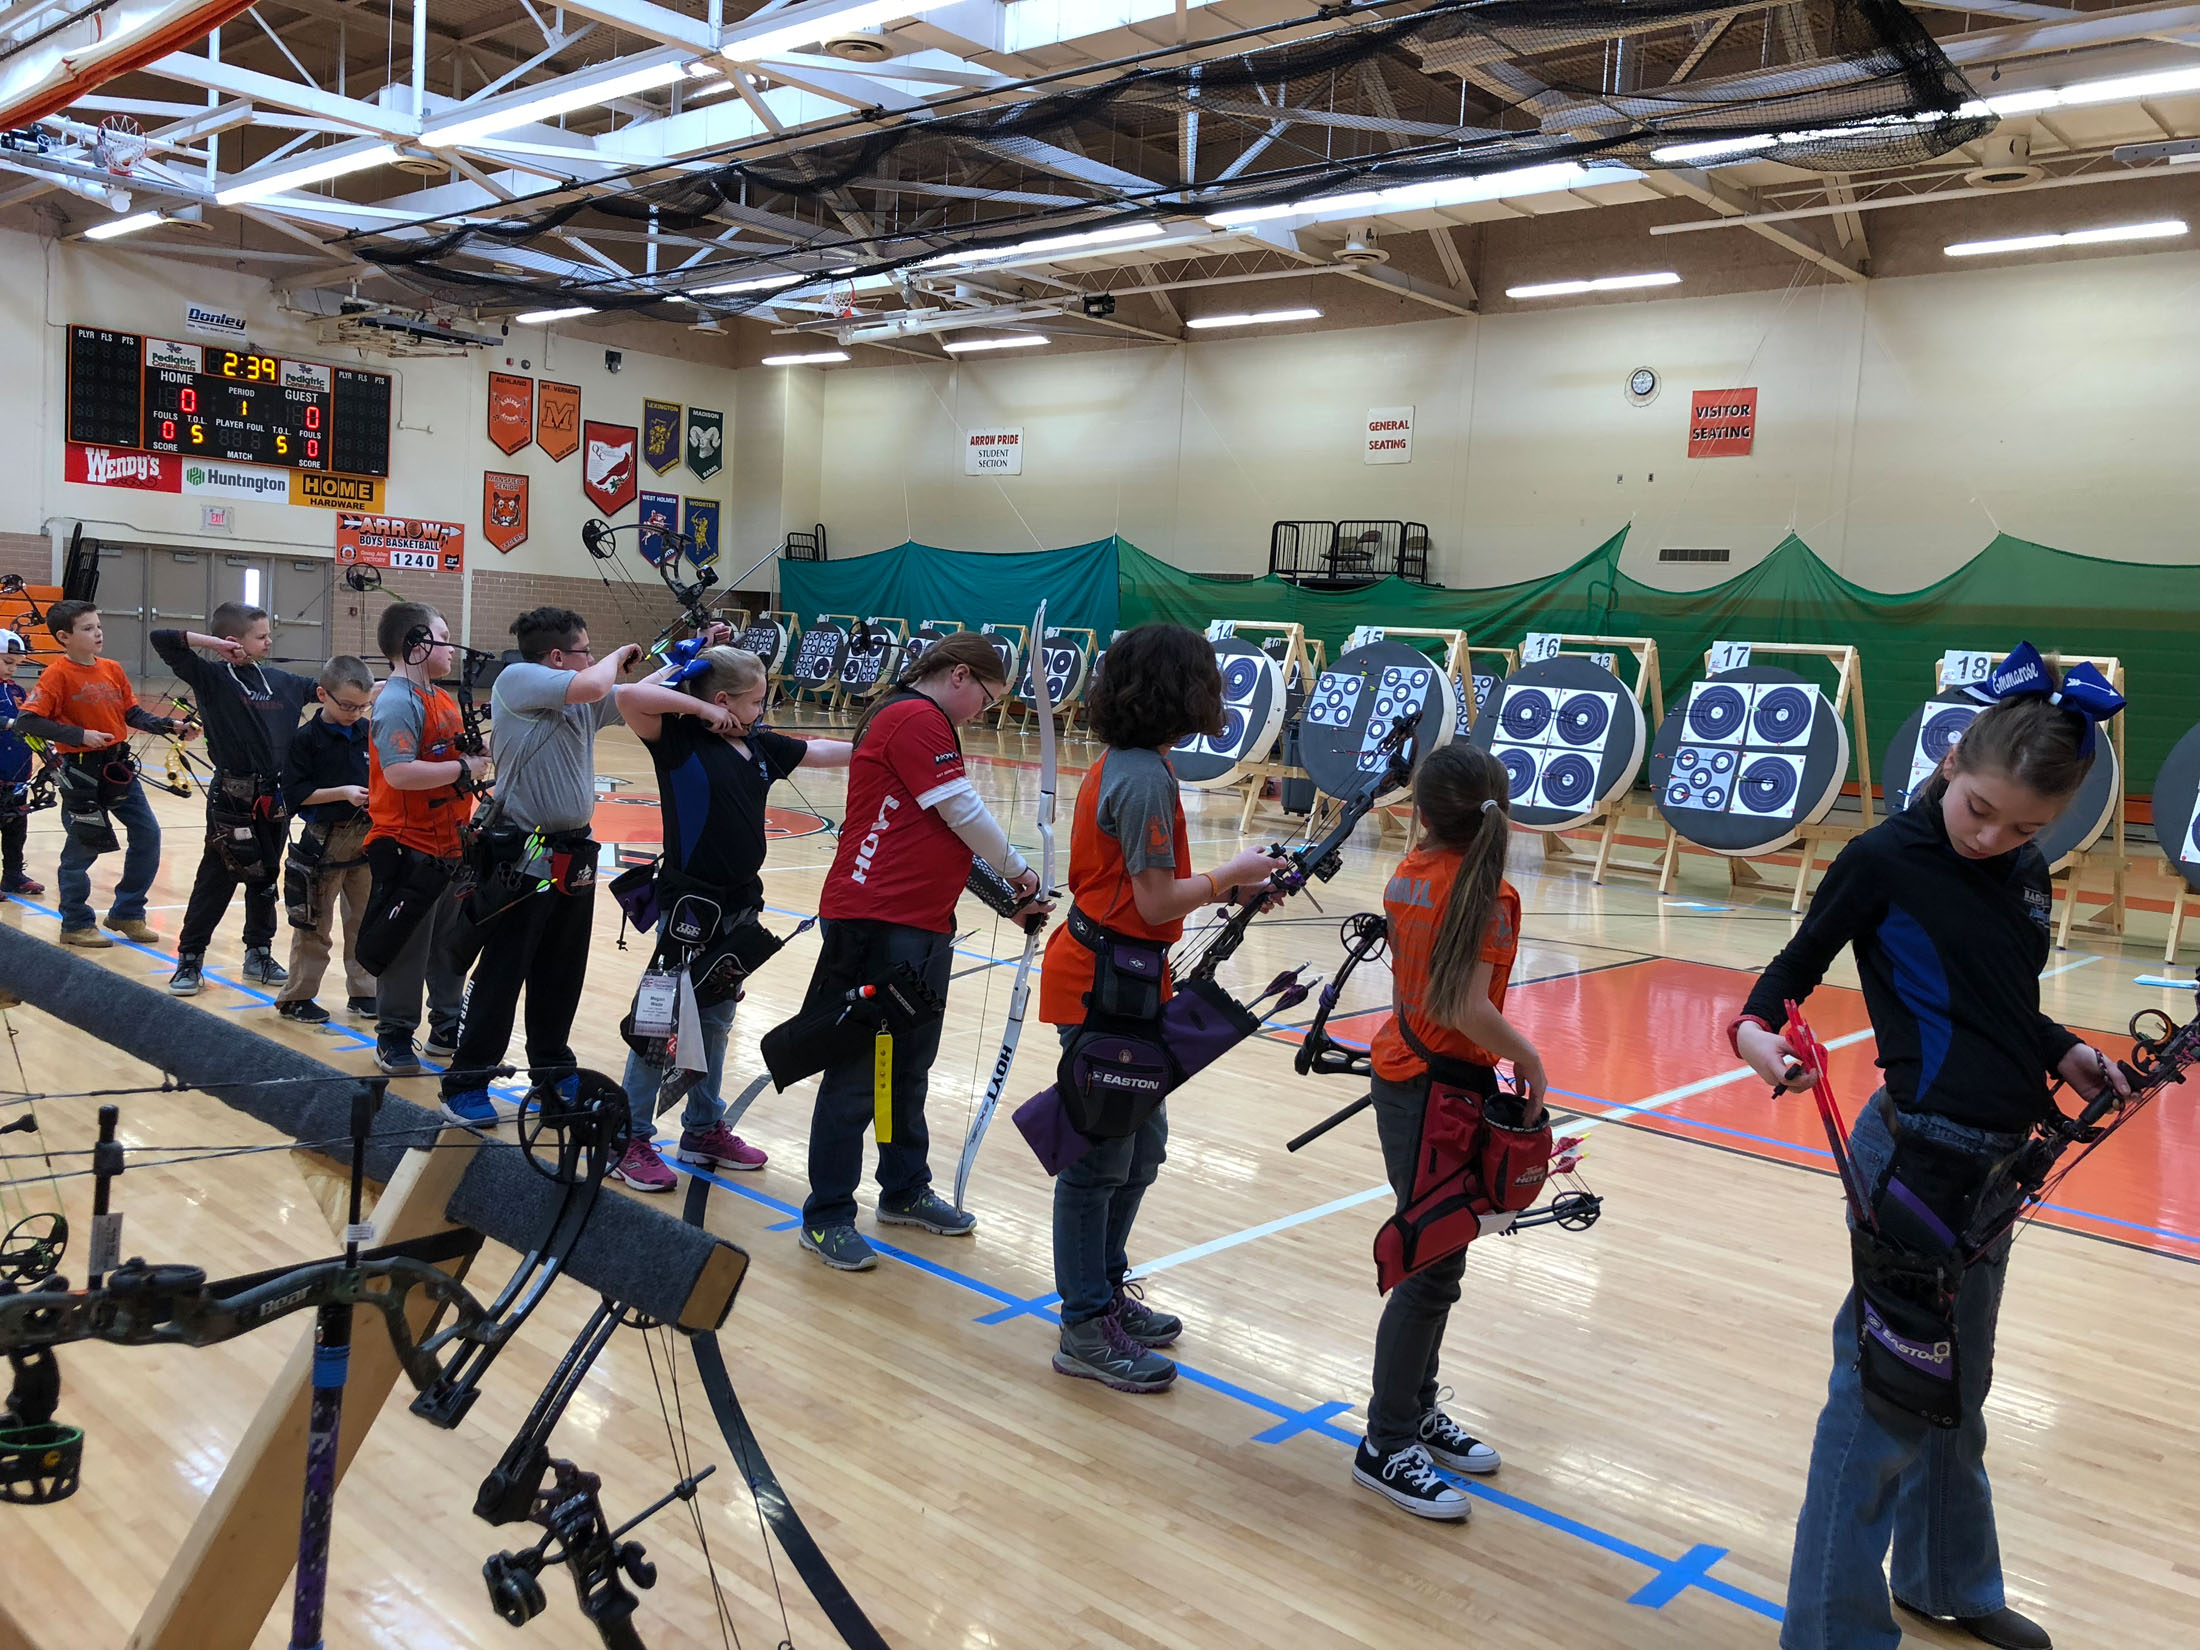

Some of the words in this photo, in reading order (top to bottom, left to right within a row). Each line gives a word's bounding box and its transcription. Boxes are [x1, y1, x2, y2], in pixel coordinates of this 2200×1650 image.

[187, 307, 246, 330] Donley
[78, 329, 95, 339] PLYR
[101, 333, 113, 342] FLS
[121, 336, 134, 345] PTS
[152, 352, 196, 366] Pediatric
[152, 360, 196, 372] Consultants
[224, 352, 275, 380] 2:39
[160, 370, 193, 385] HOME
[285, 373, 325, 386] Pediatric
[338, 371, 352, 380] PLYR
[358, 374, 367, 382] FLS
[374, 376, 385, 385] PTS
[496, 376, 527, 387] ASHLAND
[228, 386, 255, 397] PERIOD
[285, 389, 318, 403] GUEST
[553, 386, 578, 395] VERNON
[181, 388, 196, 412] 0
[647, 402, 679, 412] LEXINGTON
[153, 410, 178, 420] FOULS
[306, 406, 320, 429] 0
[692, 409, 719, 419] MADISON
[1696, 404, 1751, 419] VISITOR
[162, 420, 175, 440] 0
[216, 418, 244, 429] PLAYER
[246, 423, 265, 432] FOUL
[1369, 420, 1410, 431] GENERAL
[191, 424, 203, 444] 5
[299, 430, 321, 439] FOULS
[970, 435, 996, 446] ARROW
[997, 434, 1019, 445] PRIDE
[1692, 426, 1750, 441] SEATING
[153, 441, 178, 451] SCORE
[276, 435, 288, 454] 5
[307, 439, 319, 457] 0
[1369, 439, 1406, 450] SEATING
[227, 451, 253, 460] MATCH
[978, 449, 1009, 457] STUDENT
[298, 459, 321, 468] SCORE
[978, 459, 1008, 468] SECTION
[702, 465, 719, 477] RAMS
[208, 468, 286, 493] Huntington
[488, 475, 525, 485] MANSFIELD
[495, 483, 519, 491] SENIOR
[304, 476, 371, 499] HOME
[310, 498, 366, 511] HARDWARE
[656, 496, 676, 504] HOLMES
[689, 501, 715, 509] WOOSTER
[211, 512, 225, 525] EXIT
[360, 516, 442, 540] ARROW
[360, 535, 382, 546] BOYS
[386, 538, 440, 551] BASKETBALL
[1217, 624, 1233, 639] 14
[1363, 630, 1383, 645] 15
[1536, 637, 1560, 658] 16
[1597, 655, 1611, 668] 13
[1723, 645, 1749, 667] 17
[1957, 656, 1988, 680] 18
[1992, 662, 2039, 695] Emmarose
[851, 794, 900, 885] HOYT
[461, 979, 475, 1020] UNDER
[987, 1045, 1013, 1105] HOYT
[1102, 1073, 1160, 1090] EASTON
[259, 1286, 313, 1317] Bear
[1883, 1329, 1944, 1365] EASTON
